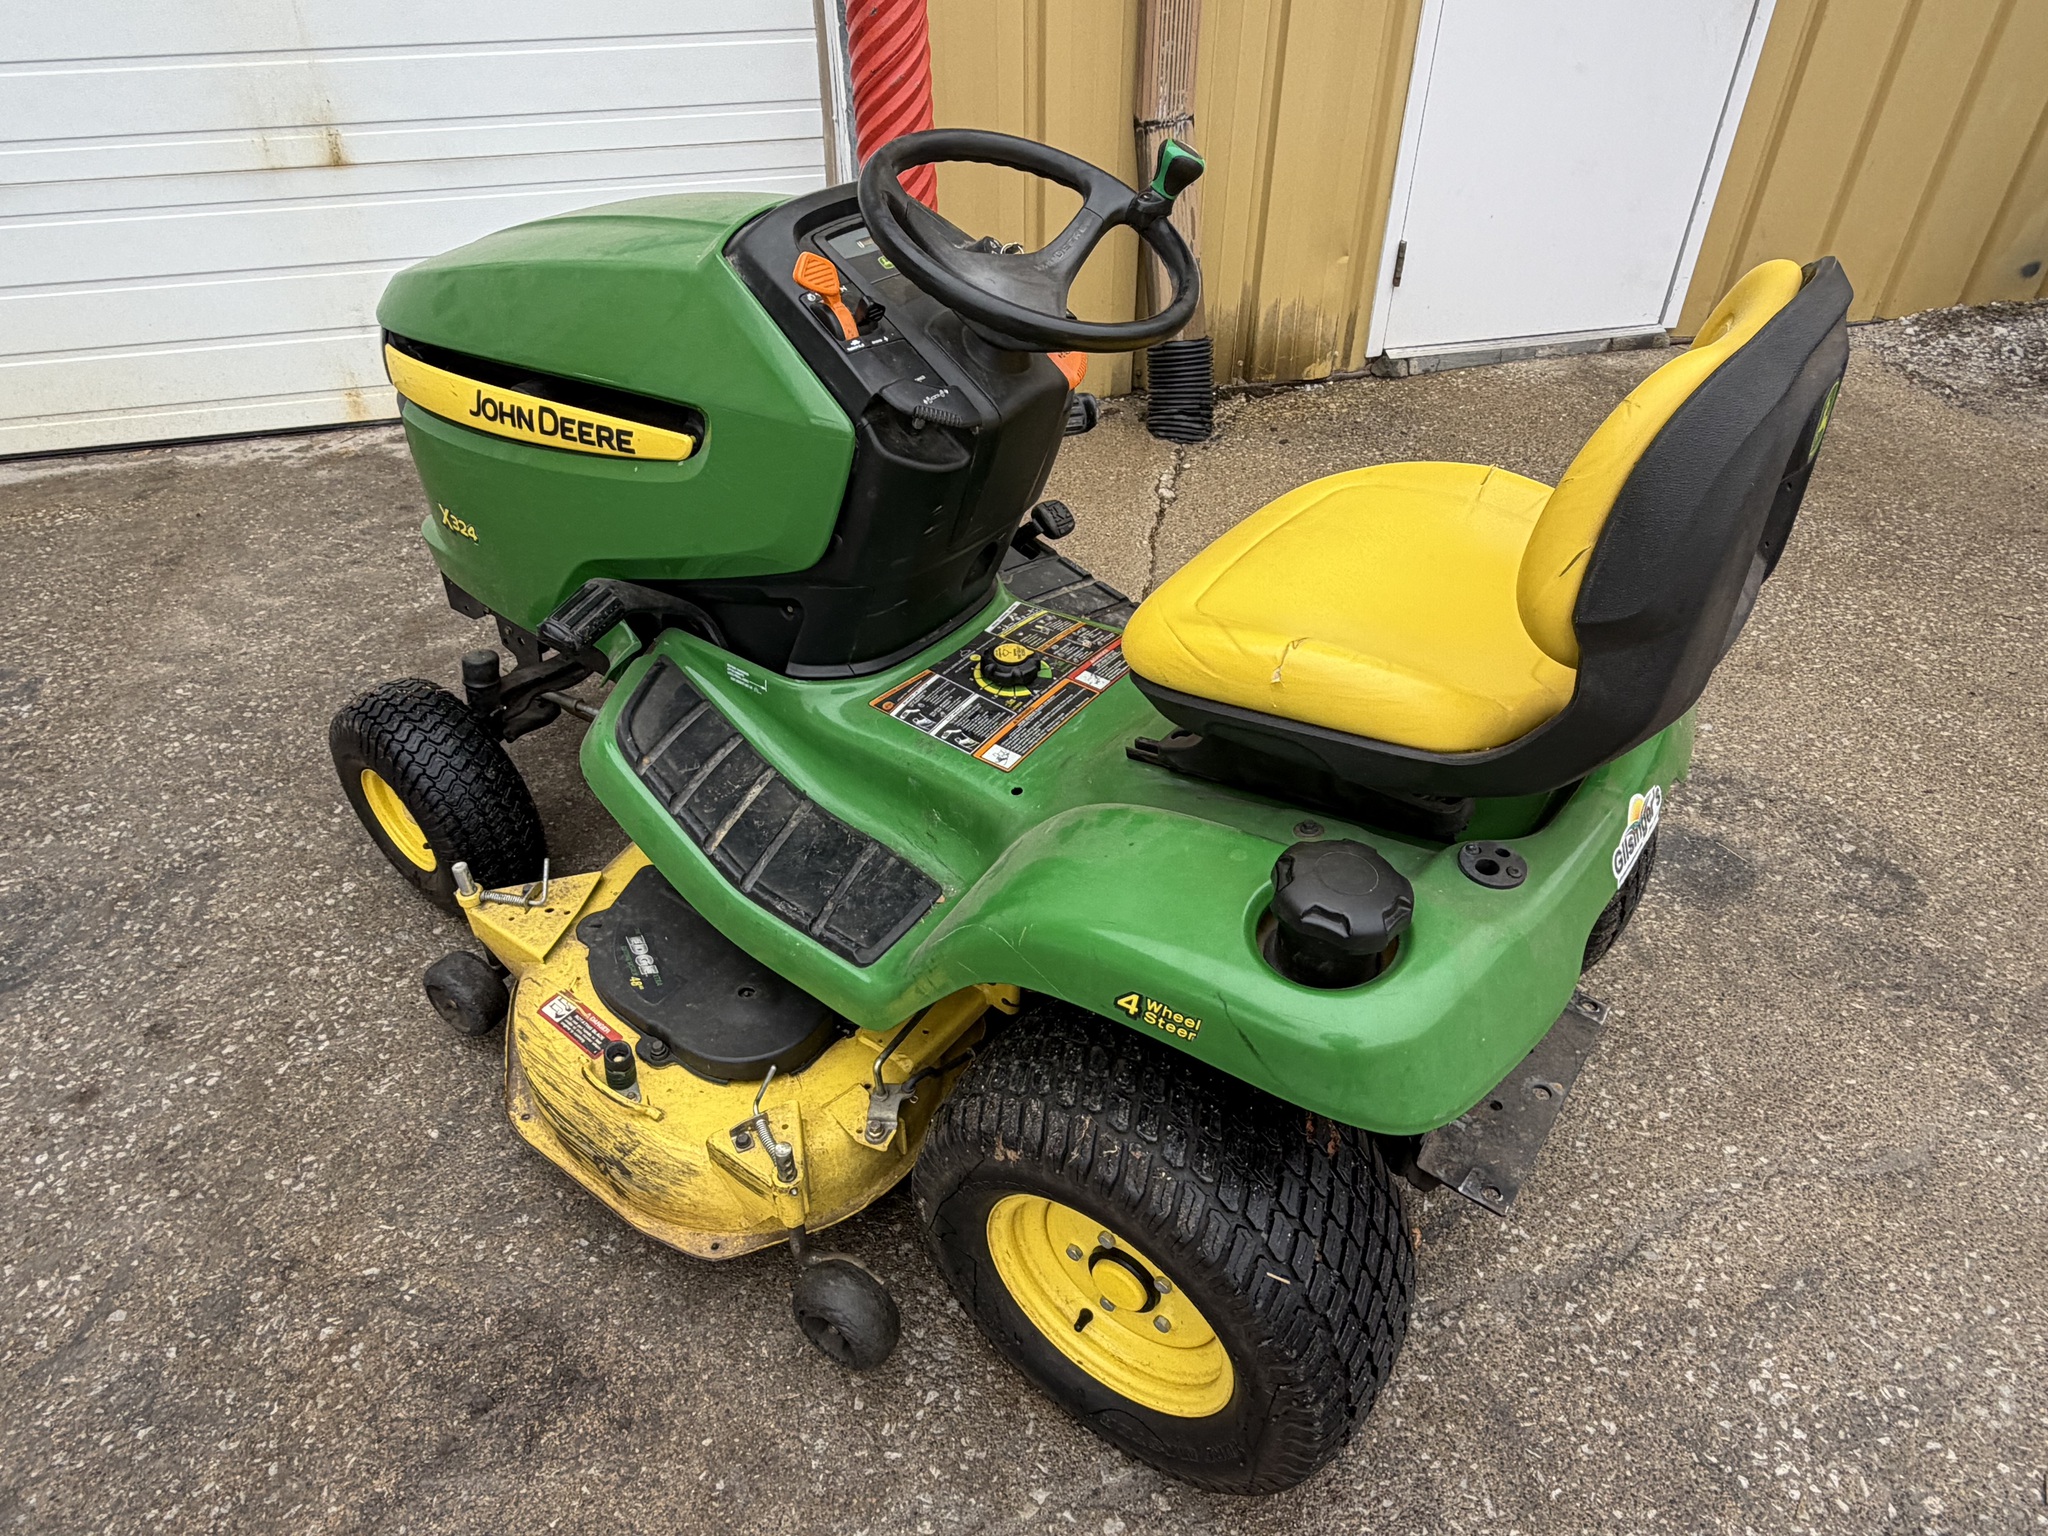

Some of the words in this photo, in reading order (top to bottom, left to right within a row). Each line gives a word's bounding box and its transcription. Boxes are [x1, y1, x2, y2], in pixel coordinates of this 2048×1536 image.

[469, 389, 535, 433] JOHN
[538, 405, 636, 455] DEERE
[438, 503, 479, 543] X324
[625, 934, 660, 976] EDGE
[1117, 993, 1140, 1016] 4
[1147, 998, 1202, 1031] Wheel
[1143, 1011, 1197, 1041] Steer
